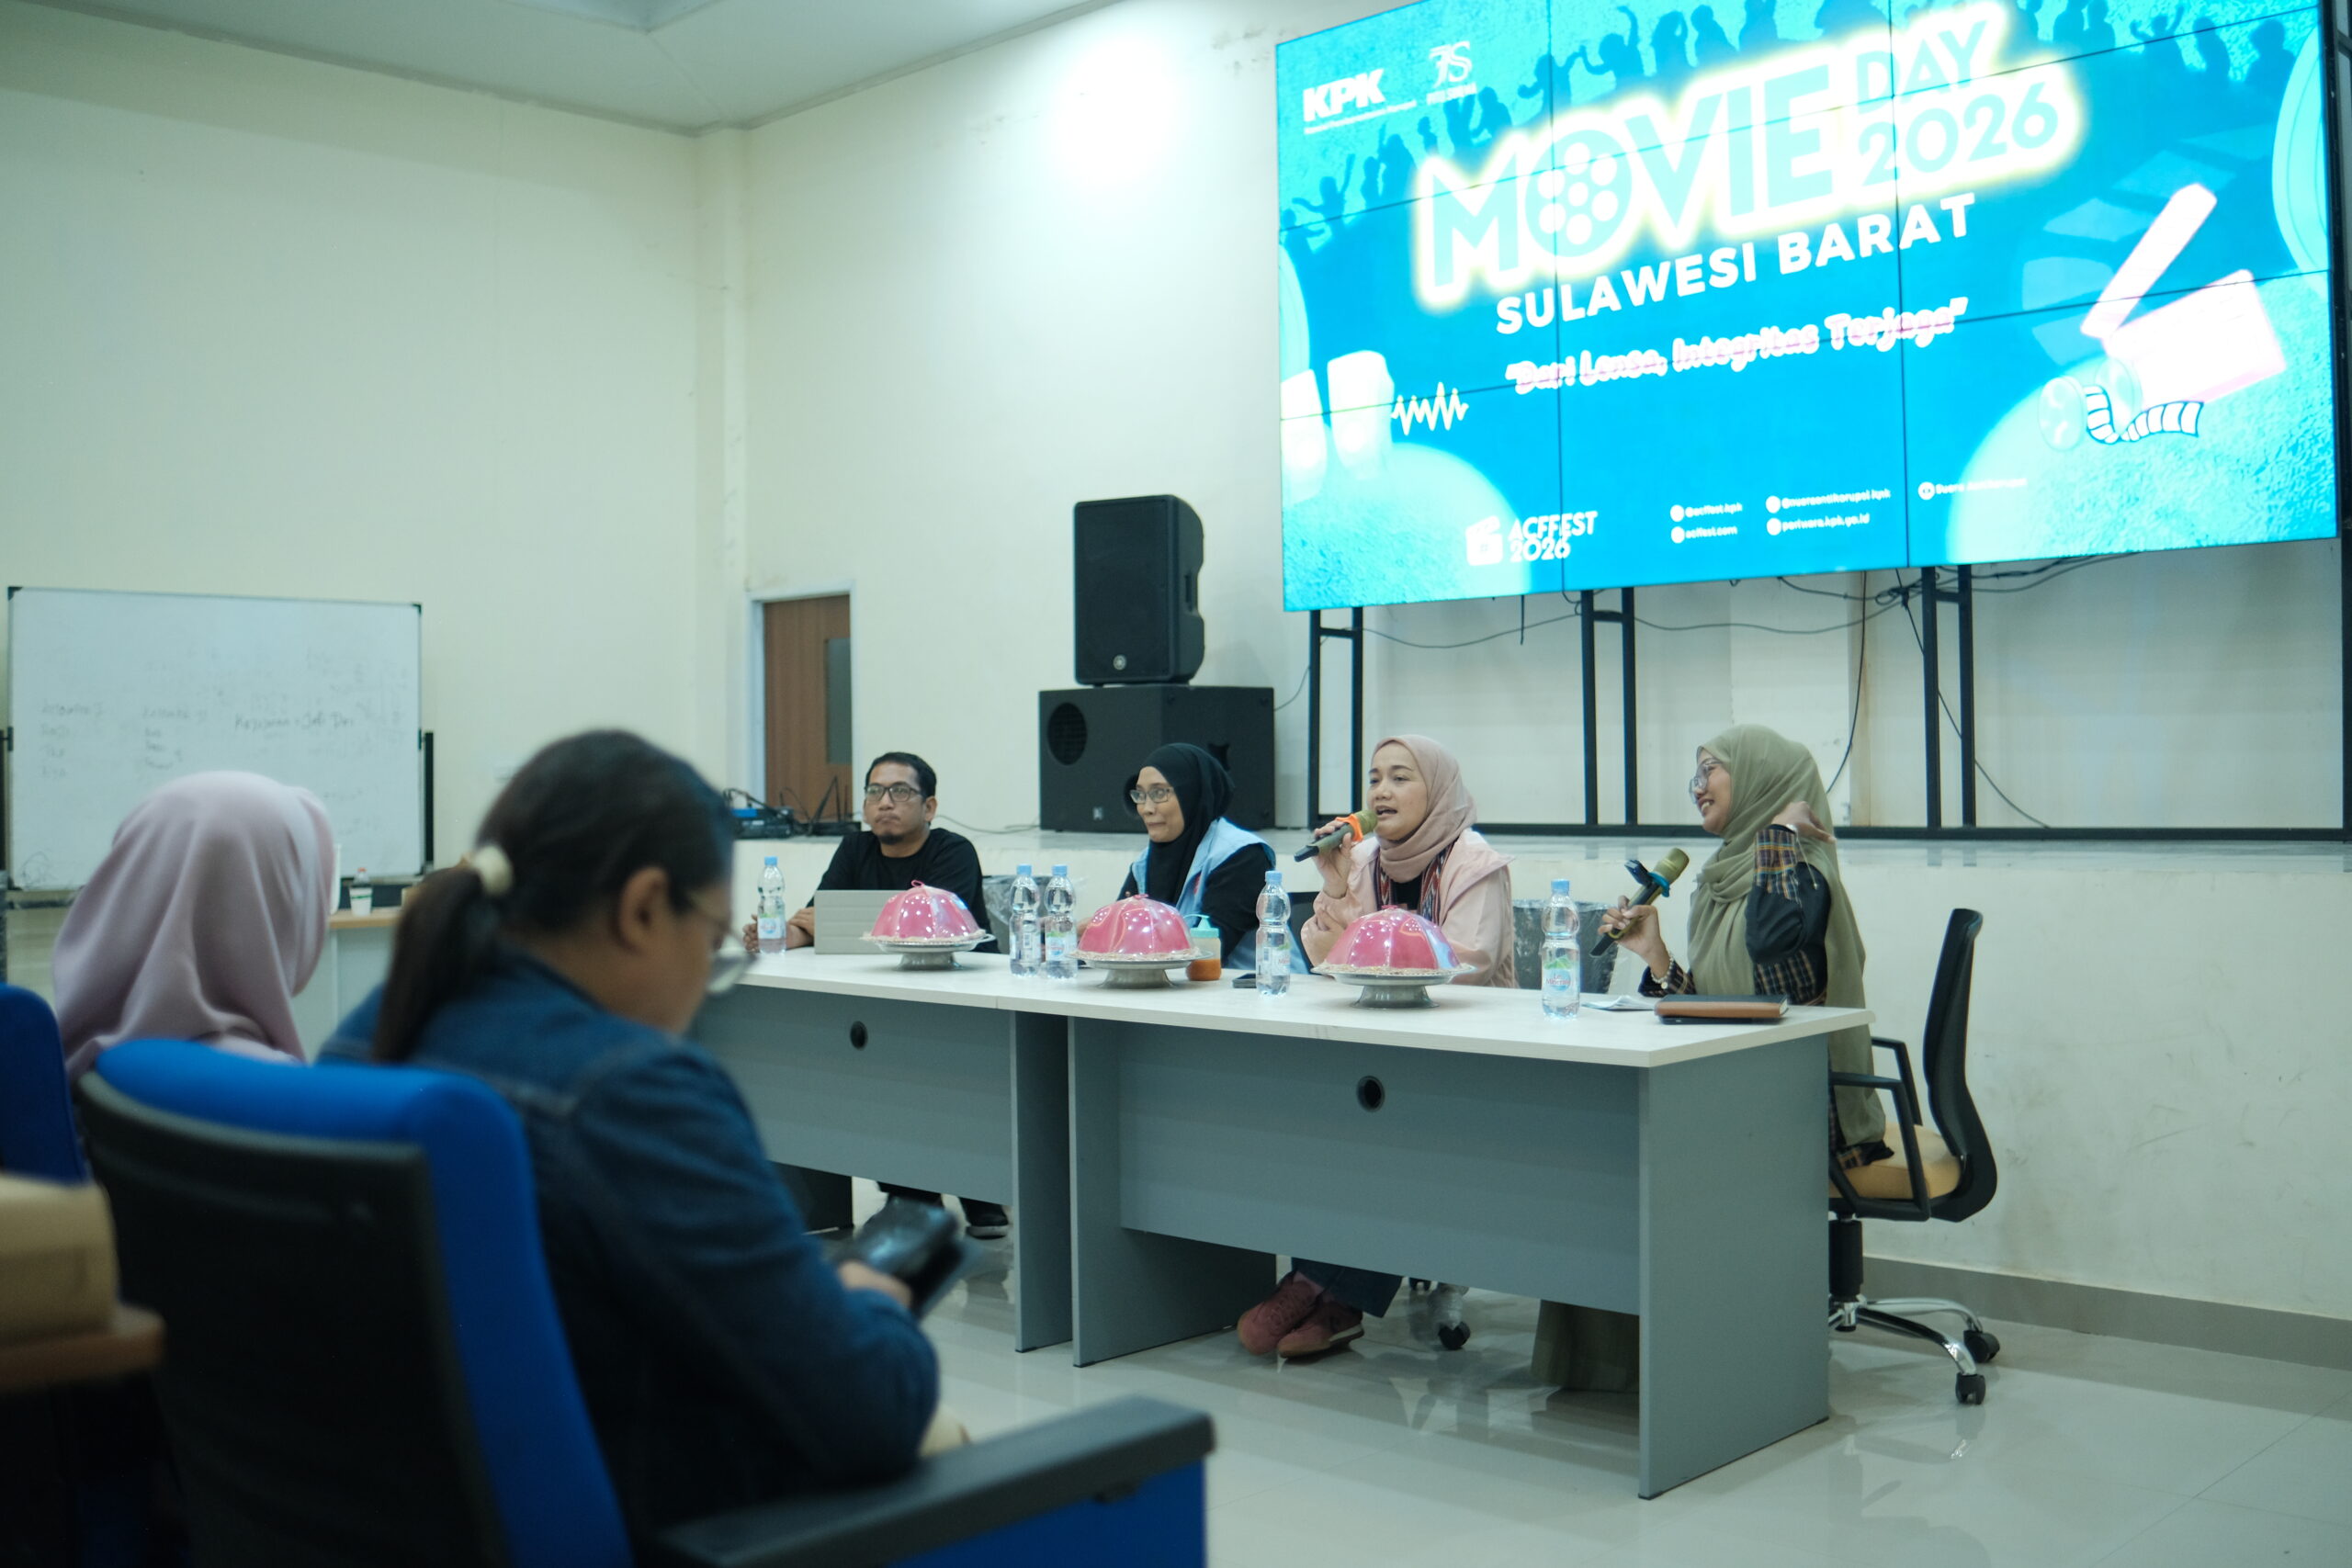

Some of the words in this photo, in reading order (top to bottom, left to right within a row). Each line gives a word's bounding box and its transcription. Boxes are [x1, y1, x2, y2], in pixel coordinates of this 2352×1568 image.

[1303, 68, 1386, 122] KPK
[1855, 19, 1988, 114] DAY
[1857, 82, 2059, 186] 2026
[1431, 62, 1834, 288] MOVIE
[1496, 242, 1757, 334] SULAWESI
[1778, 192, 1975, 275] BARAT
[1672, 323, 1820, 372] Integritas
[1508, 511, 1599, 542] ACFFEST
[1510, 536, 1571, 563] 2026
